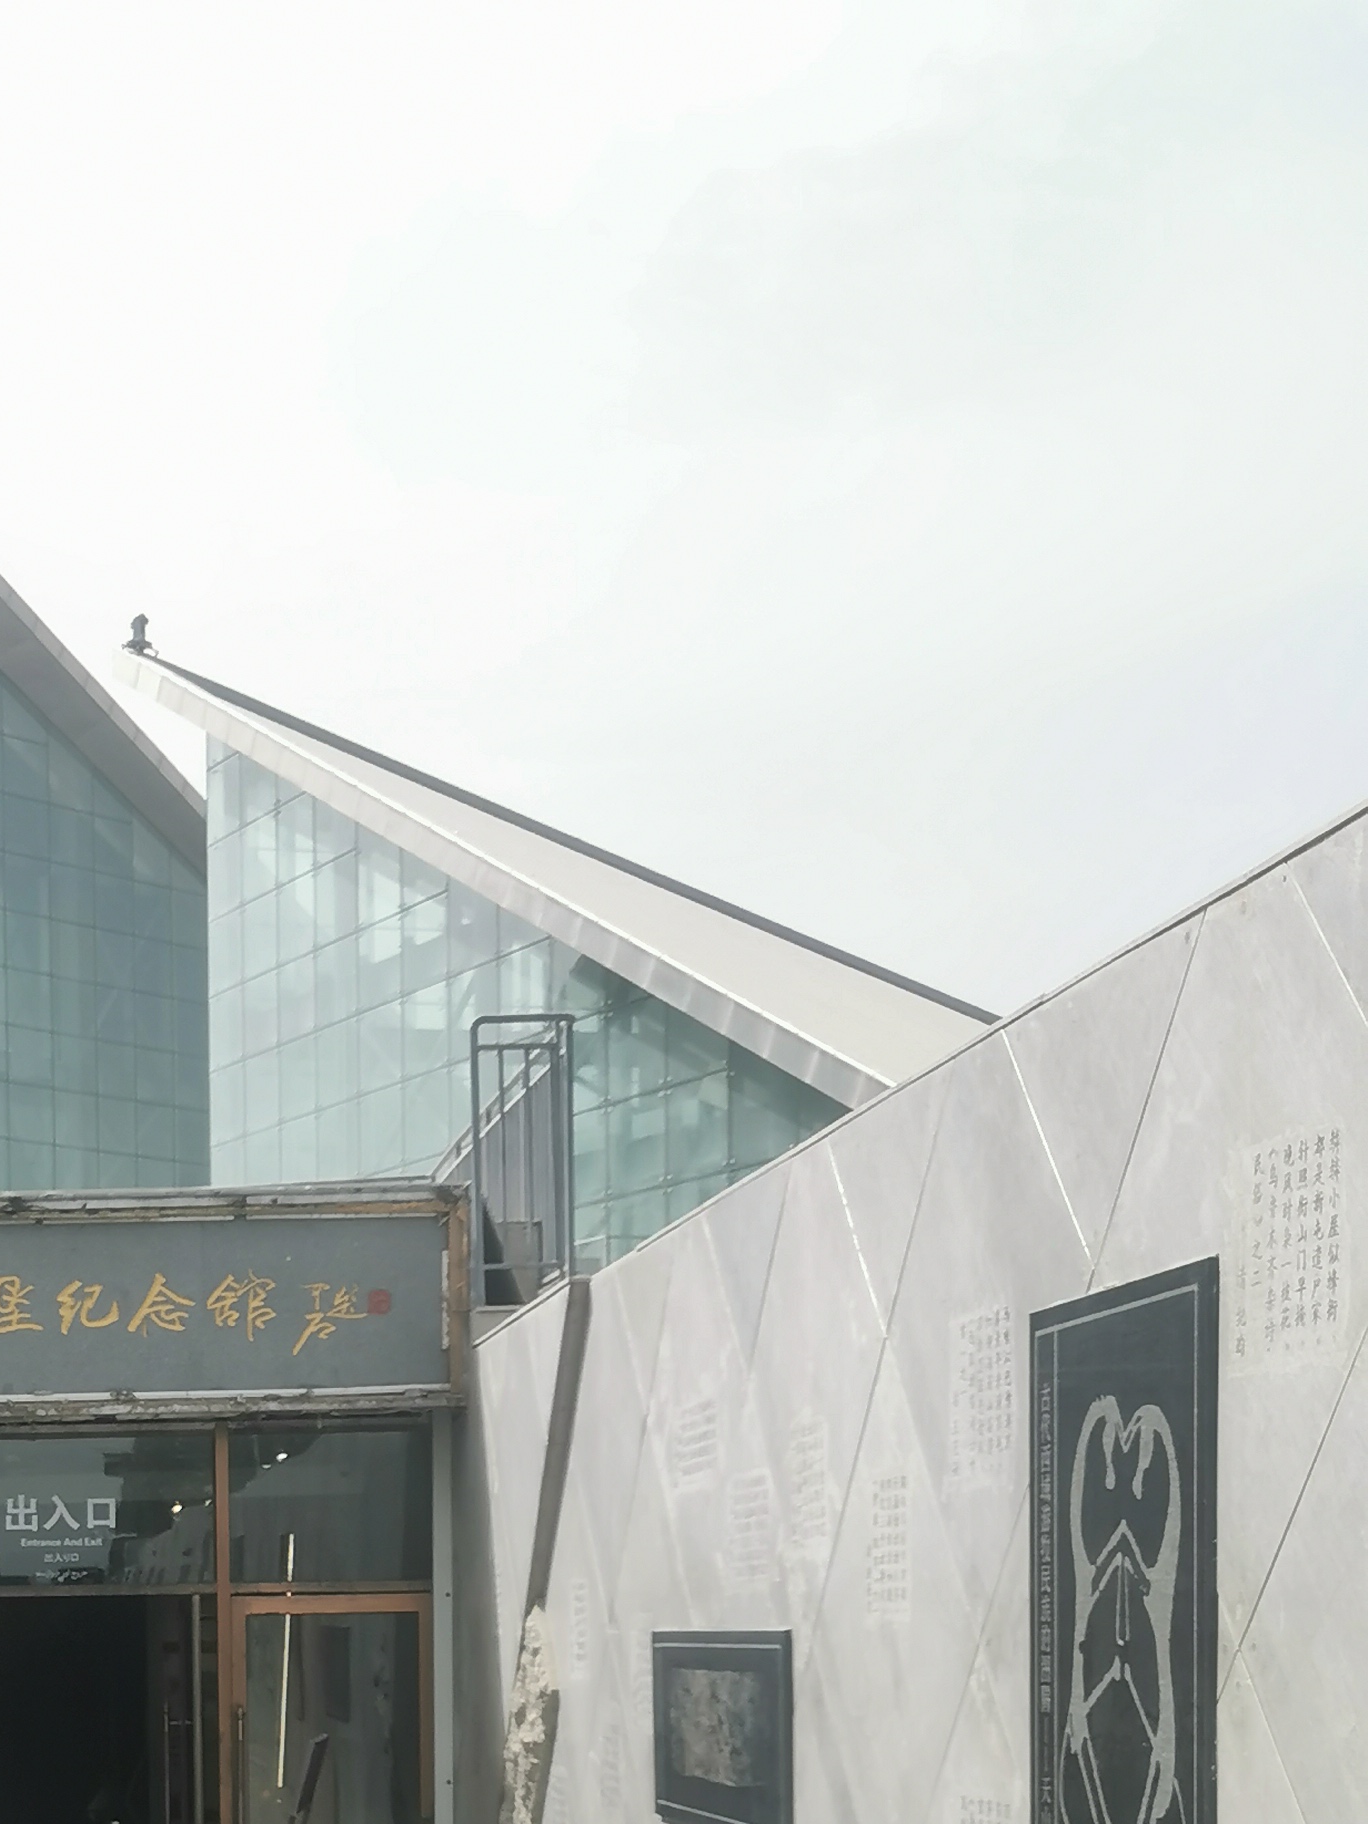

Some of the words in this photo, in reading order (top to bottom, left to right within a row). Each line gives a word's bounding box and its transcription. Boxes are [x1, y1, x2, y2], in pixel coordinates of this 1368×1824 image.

[5, 1494, 117, 1532] 出入口
[20, 1538, 61, 1547] Entrance
[63, 1538, 82, 1546] And
[84, 1537, 103, 1546] Exit
